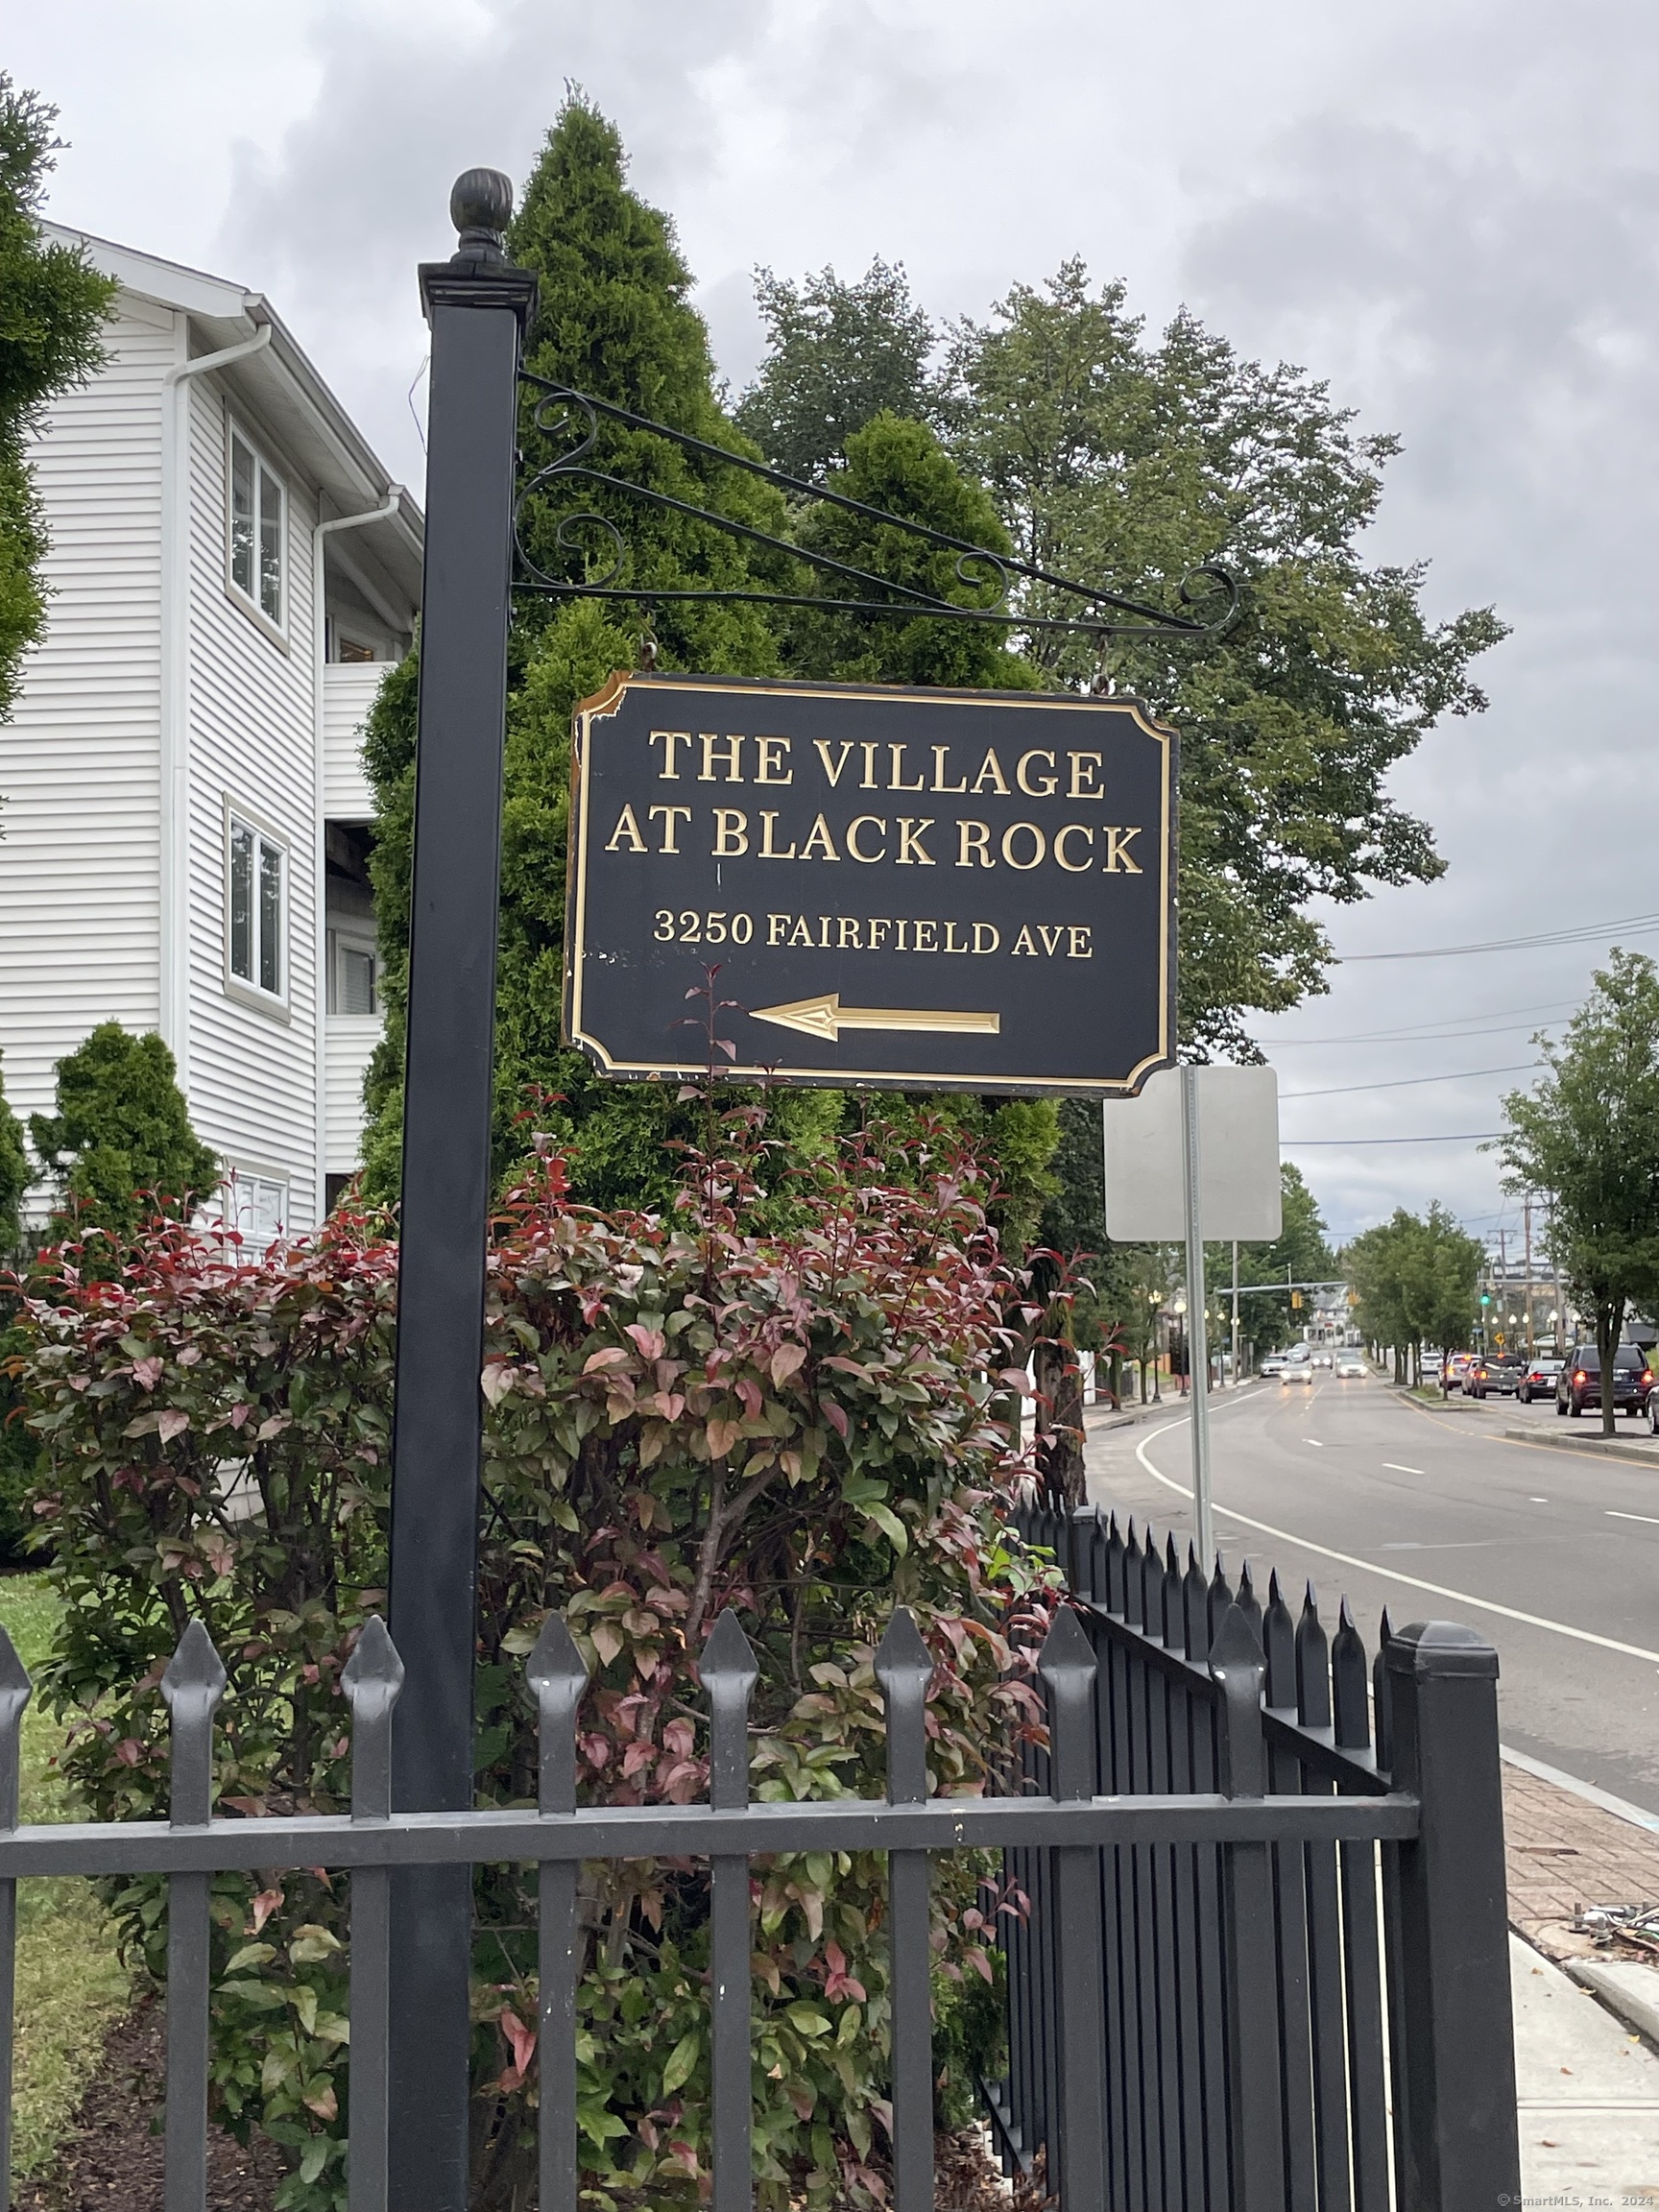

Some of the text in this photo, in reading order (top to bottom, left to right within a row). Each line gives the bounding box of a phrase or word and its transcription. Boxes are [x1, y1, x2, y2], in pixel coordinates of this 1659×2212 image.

[648, 731, 1106, 801] THE VILLAGE
[604, 803, 1144, 876] AT BLACK ROCK
[653, 909, 1094, 959] 3250 FAIRFIELD AVE
